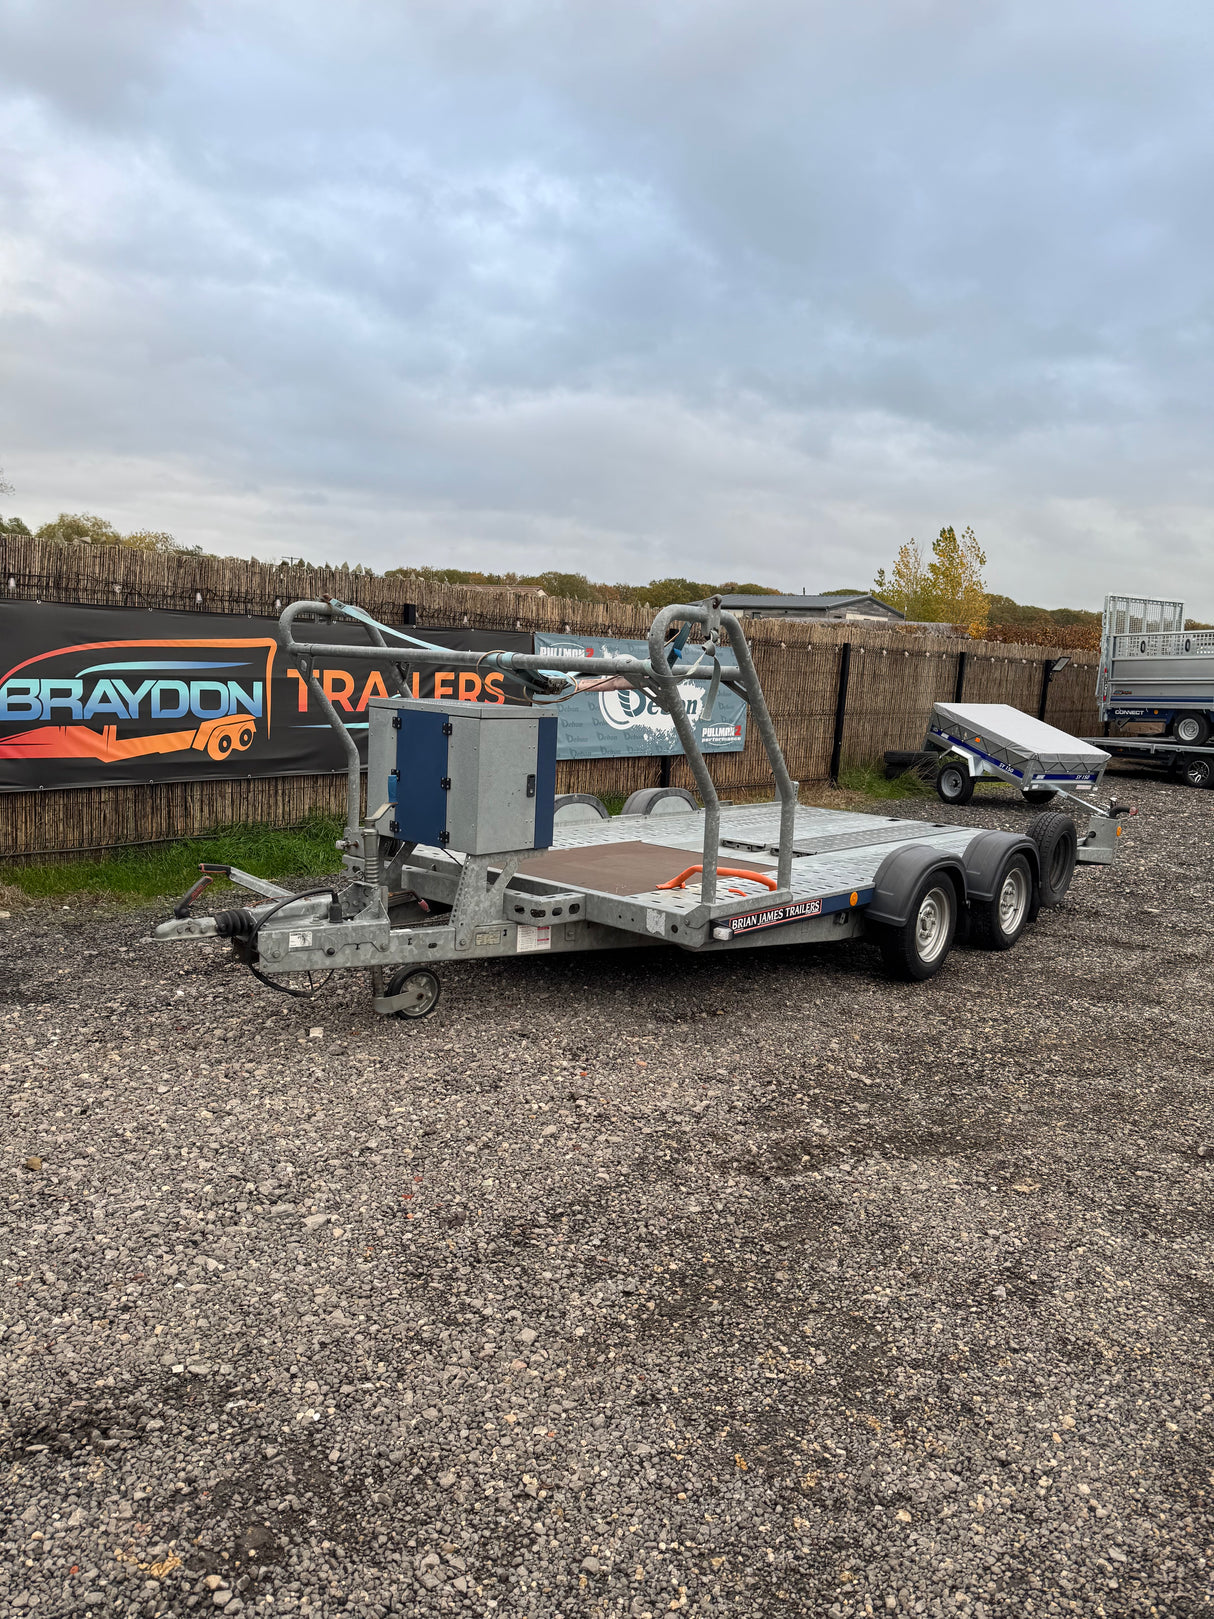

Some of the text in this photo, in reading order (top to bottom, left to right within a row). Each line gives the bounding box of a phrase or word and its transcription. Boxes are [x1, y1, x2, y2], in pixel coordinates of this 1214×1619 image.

[0, 668, 505, 720] BRAYDON TRAERS
[616, 688, 698, 718] Den
[732, 900, 820, 930] BRIAN JAMES TRAILERS
